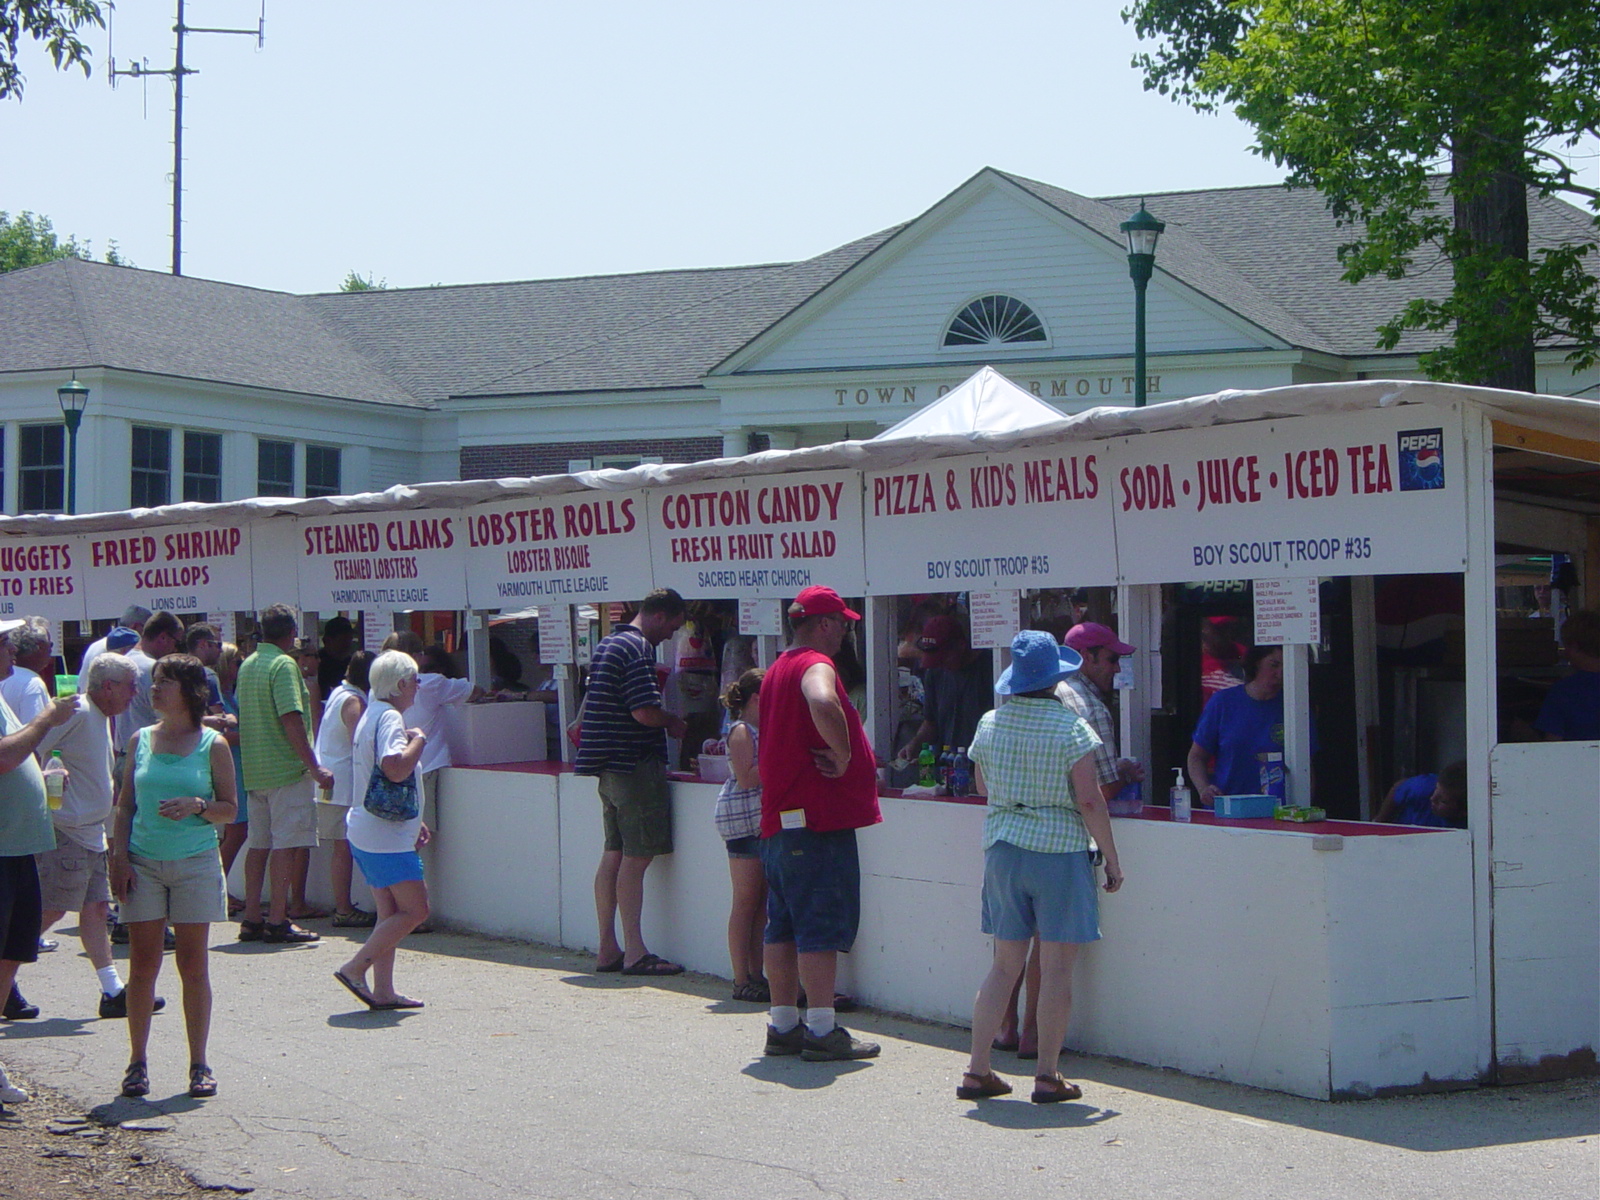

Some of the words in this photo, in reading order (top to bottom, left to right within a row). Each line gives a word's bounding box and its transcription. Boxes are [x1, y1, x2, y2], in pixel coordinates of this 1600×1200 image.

[836, 386, 916, 406] TOWN
[1029, 375, 1161, 398] RMOUTH
[1400, 433, 1441, 452] PEPSI
[874, 472, 937, 517] PIZZA
[945, 469, 962, 511] &
[970, 463, 1017, 508] KID'S
[1024, 454, 1099, 504] MEALS
[1120, 464, 1176, 511] SODA
[1197, 456, 1261, 512] JUICE
[1285, 448, 1339, 499] ICED
[1347, 444, 1393, 494] TEA
[662, 489, 751, 530] COTTON
[757, 482, 844, 524] CANDY
[304, 522, 380, 556] STEAMED
[386, 517, 455, 552] CLAMS
[467, 507, 558, 548] LOBSTER
[563, 498, 636, 538] ROLLS
[0, 544, 72, 572] UGGETS
[91, 535, 158, 568] FRIED
[163, 527, 242, 562] SHRIMP
[507, 547, 553, 574] LOBSTER
[554, 544, 592, 571] BISQUE
[671, 536, 723, 563] FRESH
[728, 533, 774, 560] FRUIT
[780, 530, 837, 559] SALAD
[1193, 545, 1225, 566] BOY
[1229, 541, 1282, 564] SCOUT
[1286, 538, 1341, 562] TROOP
[1345, 537, 1372, 559] #35
[134, 565, 210, 590] SCALLOPS
[333, 558, 373, 581] STEAMED
[373, 556, 419, 580] LOBSTERS
[698, 571, 737, 588] SACRED
[738, 570, 769, 586] HEART
[771, 569, 812, 586] CHURCH
[927, 561, 951, 579] BOY
[954, 558, 991, 578] SCOUT
[994, 556, 1029, 576] TROOP
[1031, 555, 1050, 574] #35
[0, 577, 23, 596] TO
[29, 576, 75, 596] FRIES
[331, 590, 372, 604] YARMOUTH
[371, 589, 396, 603] LITTLE
[396, 588, 430, 602] LEAGUE
[496, 580, 544, 597] YARMOUTH
[544, 577, 573, 595] LITTLE
[573, 576, 610, 592] LEAGUE
[1203, 579, 1248, 593] PEPSI
[151, 598, 176, 611] LIONS
[176, 596, 198, 609] CLUB
